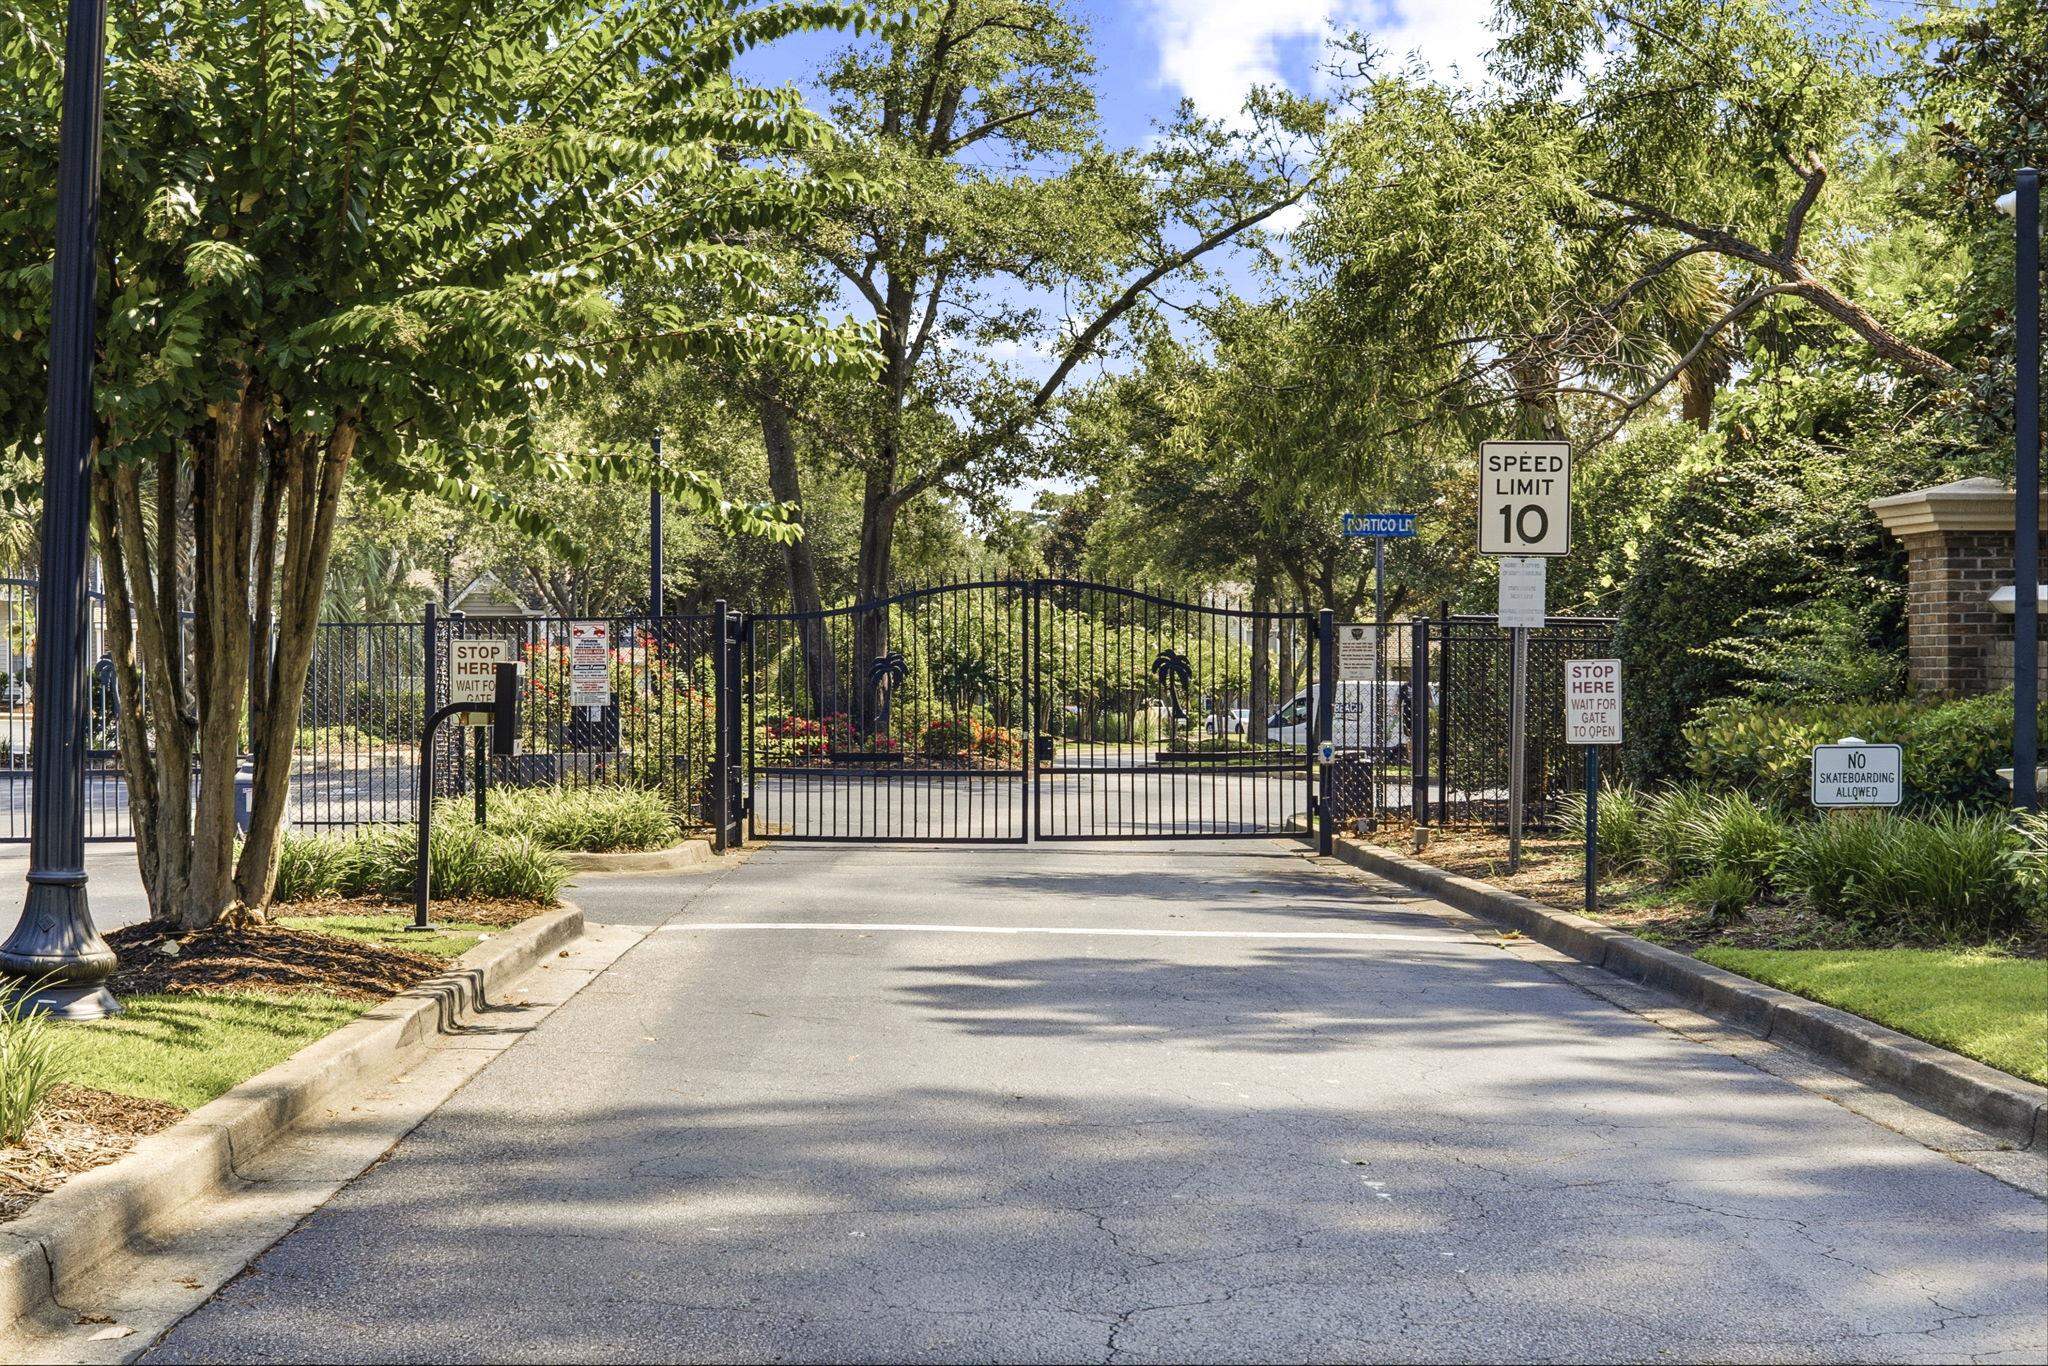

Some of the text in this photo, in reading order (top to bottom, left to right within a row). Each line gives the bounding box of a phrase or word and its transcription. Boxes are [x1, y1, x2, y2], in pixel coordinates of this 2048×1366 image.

[1489, 456, 1563, 472] SPEED
[1496, 479, 1554, 495] LIMIT
[1499, 504, 1549, 544] 10
[457, 646, 500, 659] STOP
[457, 662, 497, 675] HERE
[1572, 666, 1614, 678] STOP
[456, 680, 496, 692] WAIT FO
[1572, 682, 1614, 693] HERE
[467, 693, 492, 702] GATE
[1572, 699, 1616, 710] WAIT FOR
[1581, 712, 1607, 724] GATE
[1573, 726, 1615, 738] TO OPEN
[1848, 753, 1866, 769] NO
[1819, 772, 1895, 784] SKATEBOARDING
[1836, 787, 1878, 798] ALLOWED
